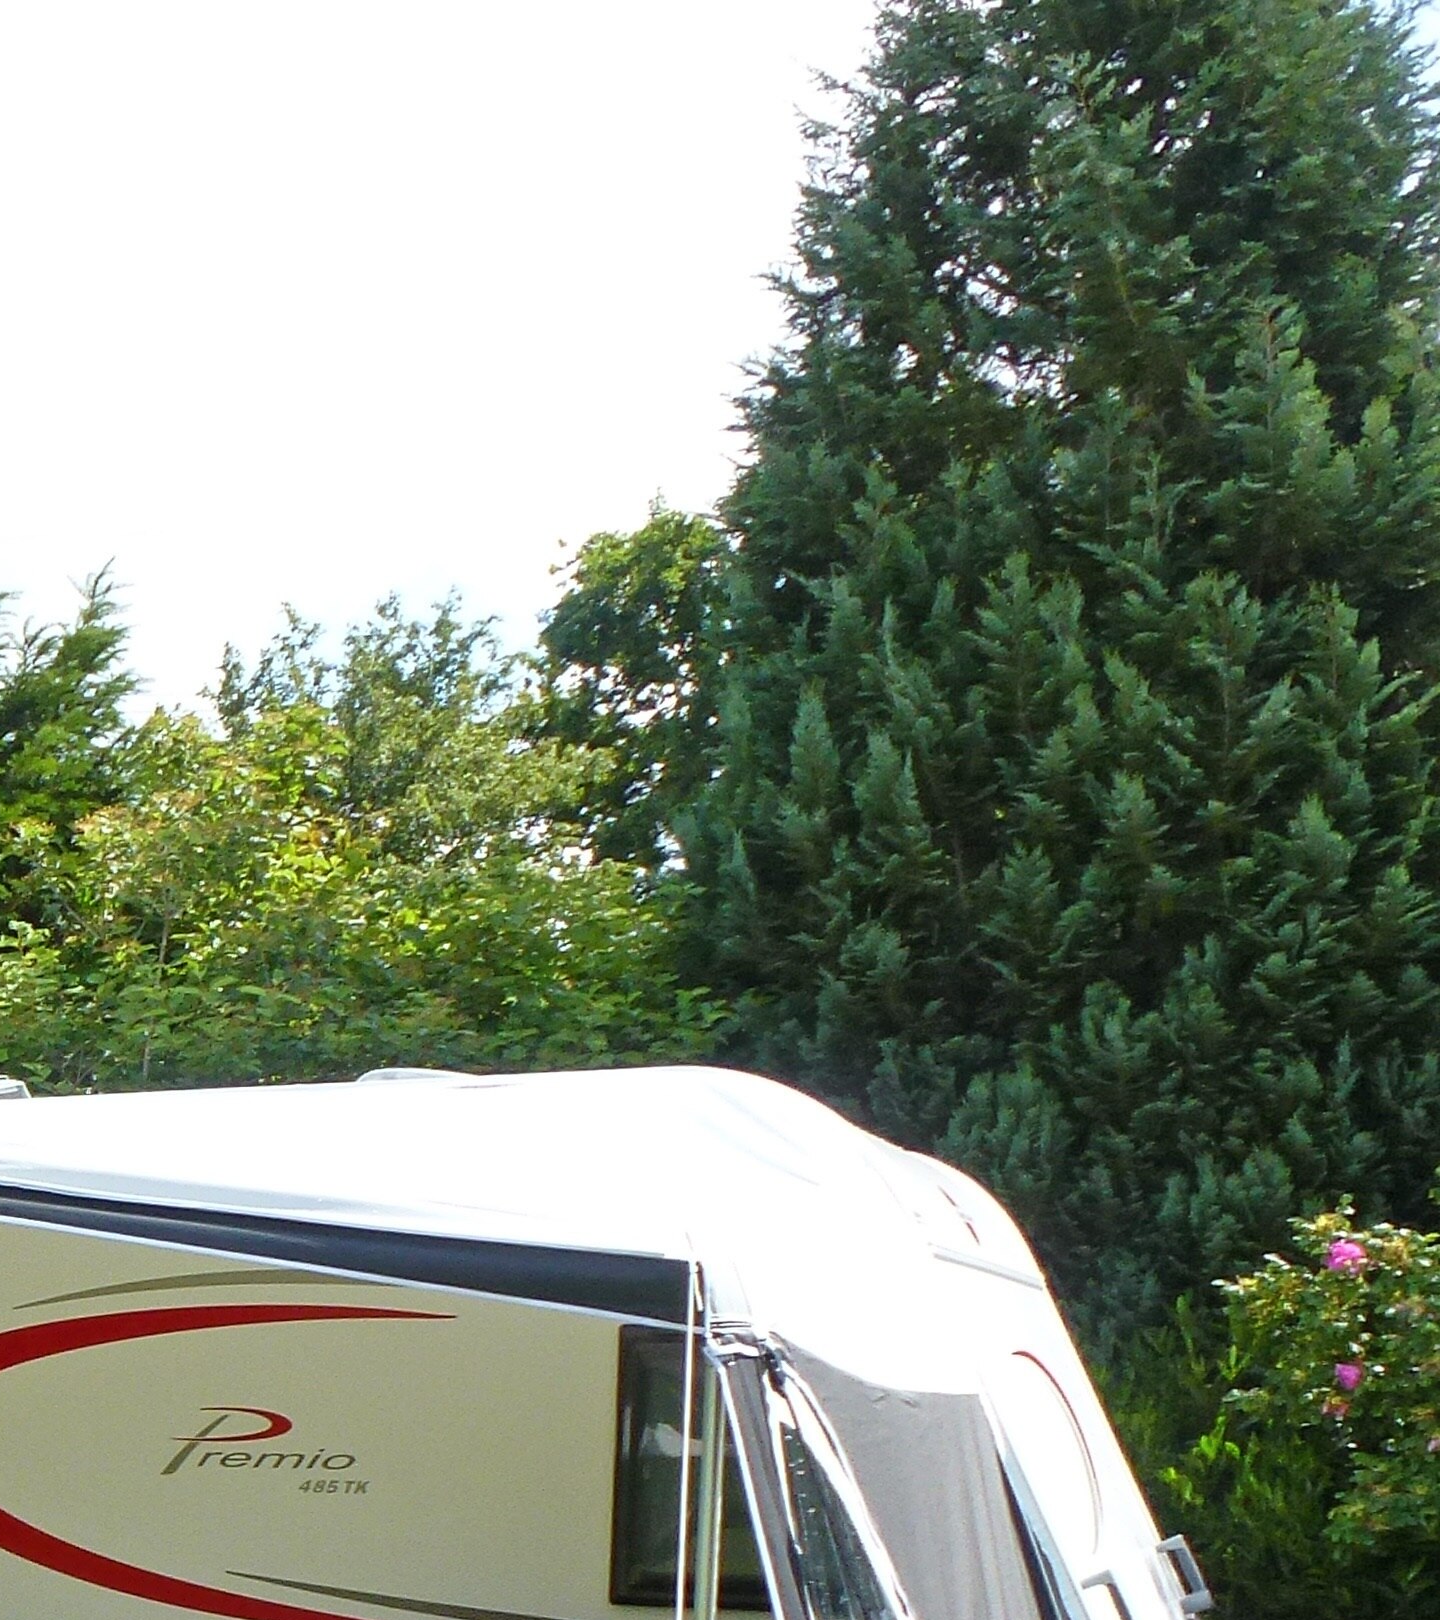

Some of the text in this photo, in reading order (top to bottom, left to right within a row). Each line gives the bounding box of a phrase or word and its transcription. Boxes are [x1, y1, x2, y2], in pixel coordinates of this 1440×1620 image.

[160, 1406, 357, 1475] Premio
[298, 1479, 370, 1494] 485 TK
